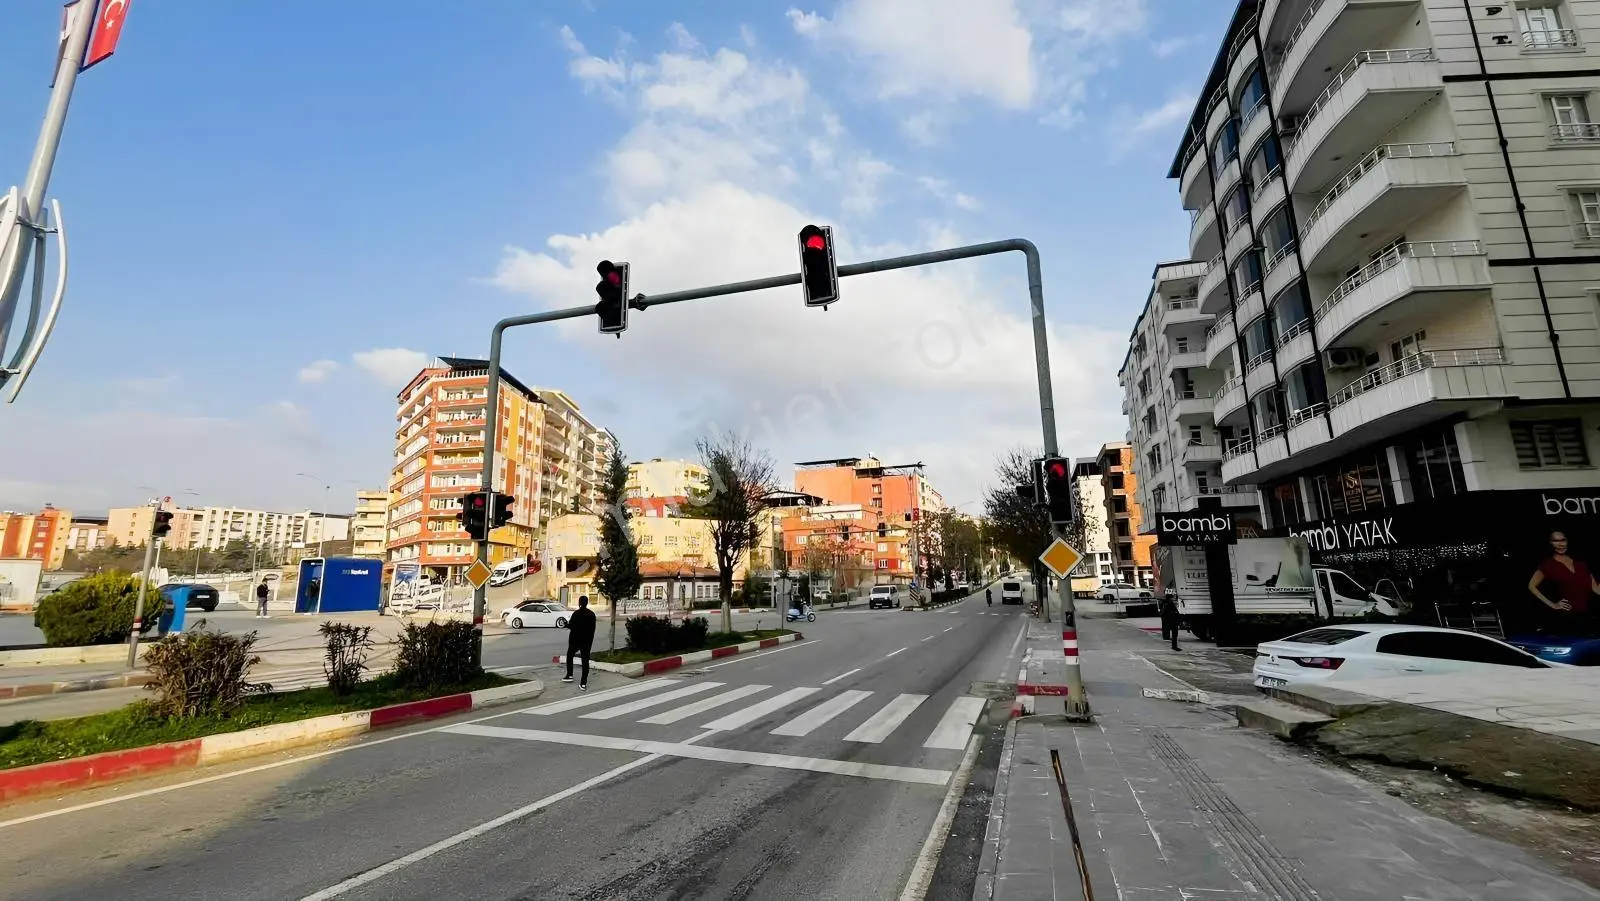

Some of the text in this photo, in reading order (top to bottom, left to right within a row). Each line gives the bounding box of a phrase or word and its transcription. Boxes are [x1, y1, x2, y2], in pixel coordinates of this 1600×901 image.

[1161, 513, 1231, 532] bambi
[1341, 516, 1398, 548] YATAK
[1177, 534, 1219, 542] YATAK
